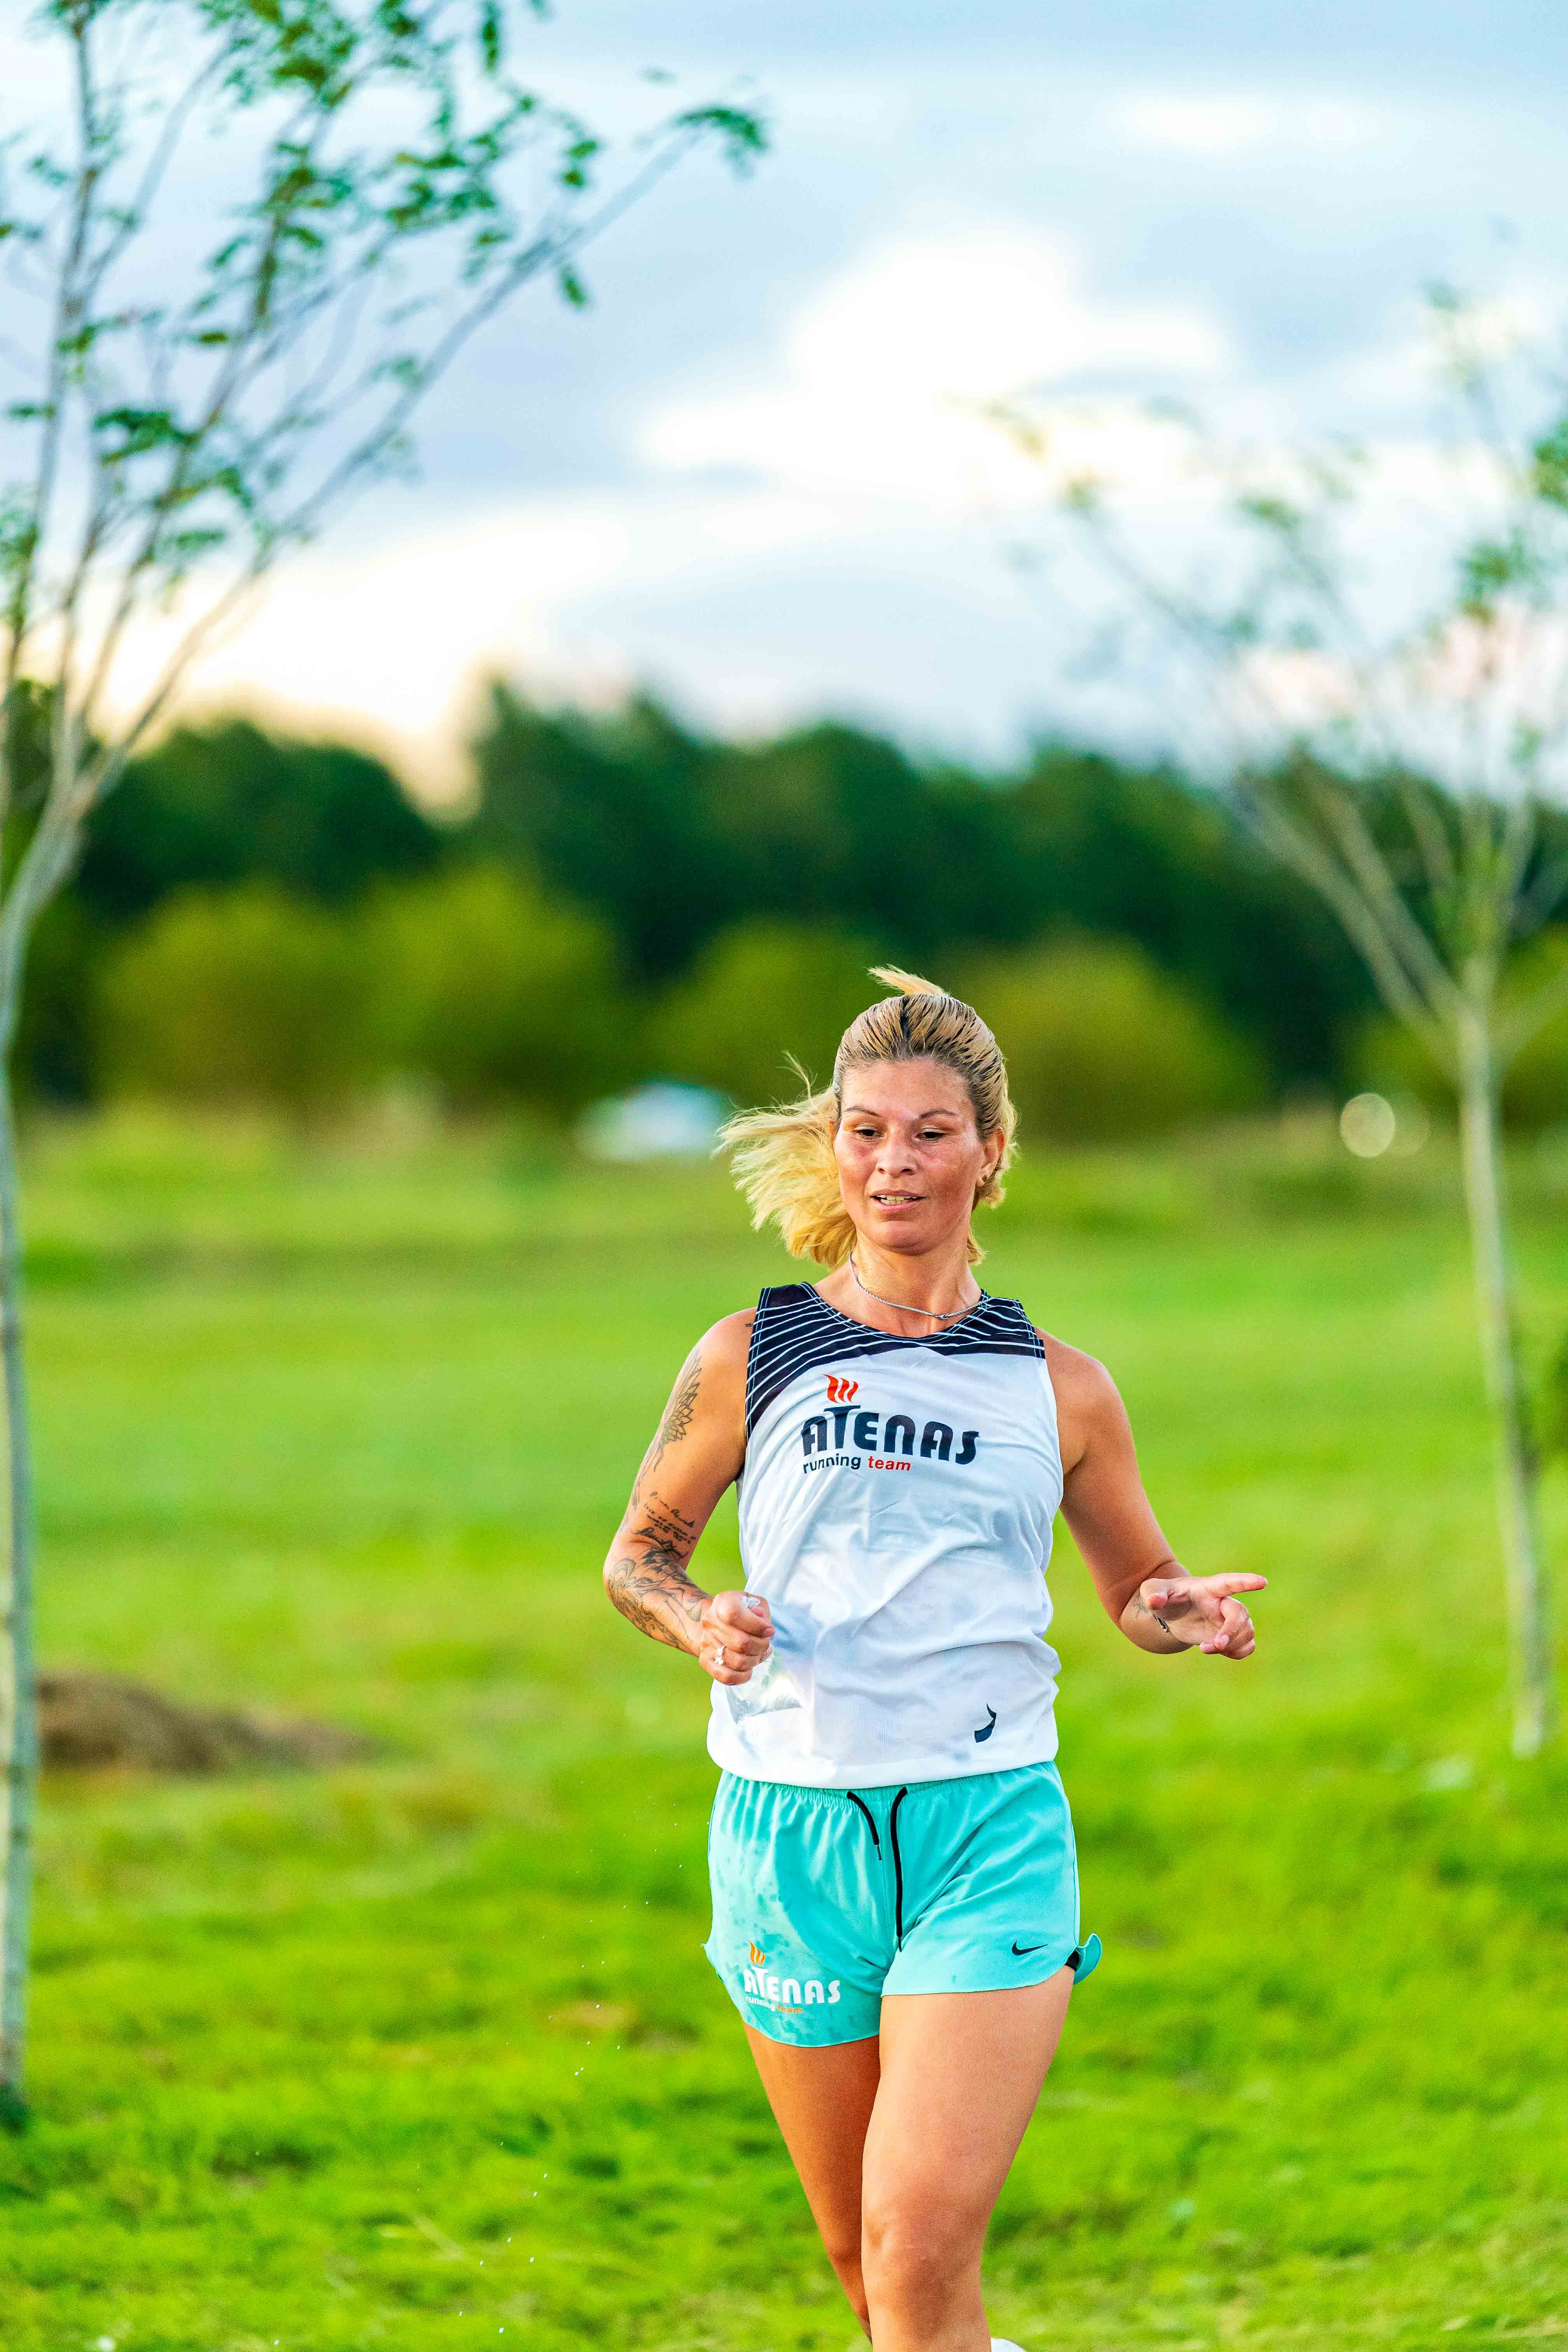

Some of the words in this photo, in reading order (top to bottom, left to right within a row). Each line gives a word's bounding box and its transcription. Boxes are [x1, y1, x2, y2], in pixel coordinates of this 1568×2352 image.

[801, 1405, 980, 1465] ATENAS
[803, 1453, 861, 1474] running
[868, 1456, 911, 1471] team
[743, 1966, 840, 2004] ATENAS
[778, 2004, 803, 2014] team
